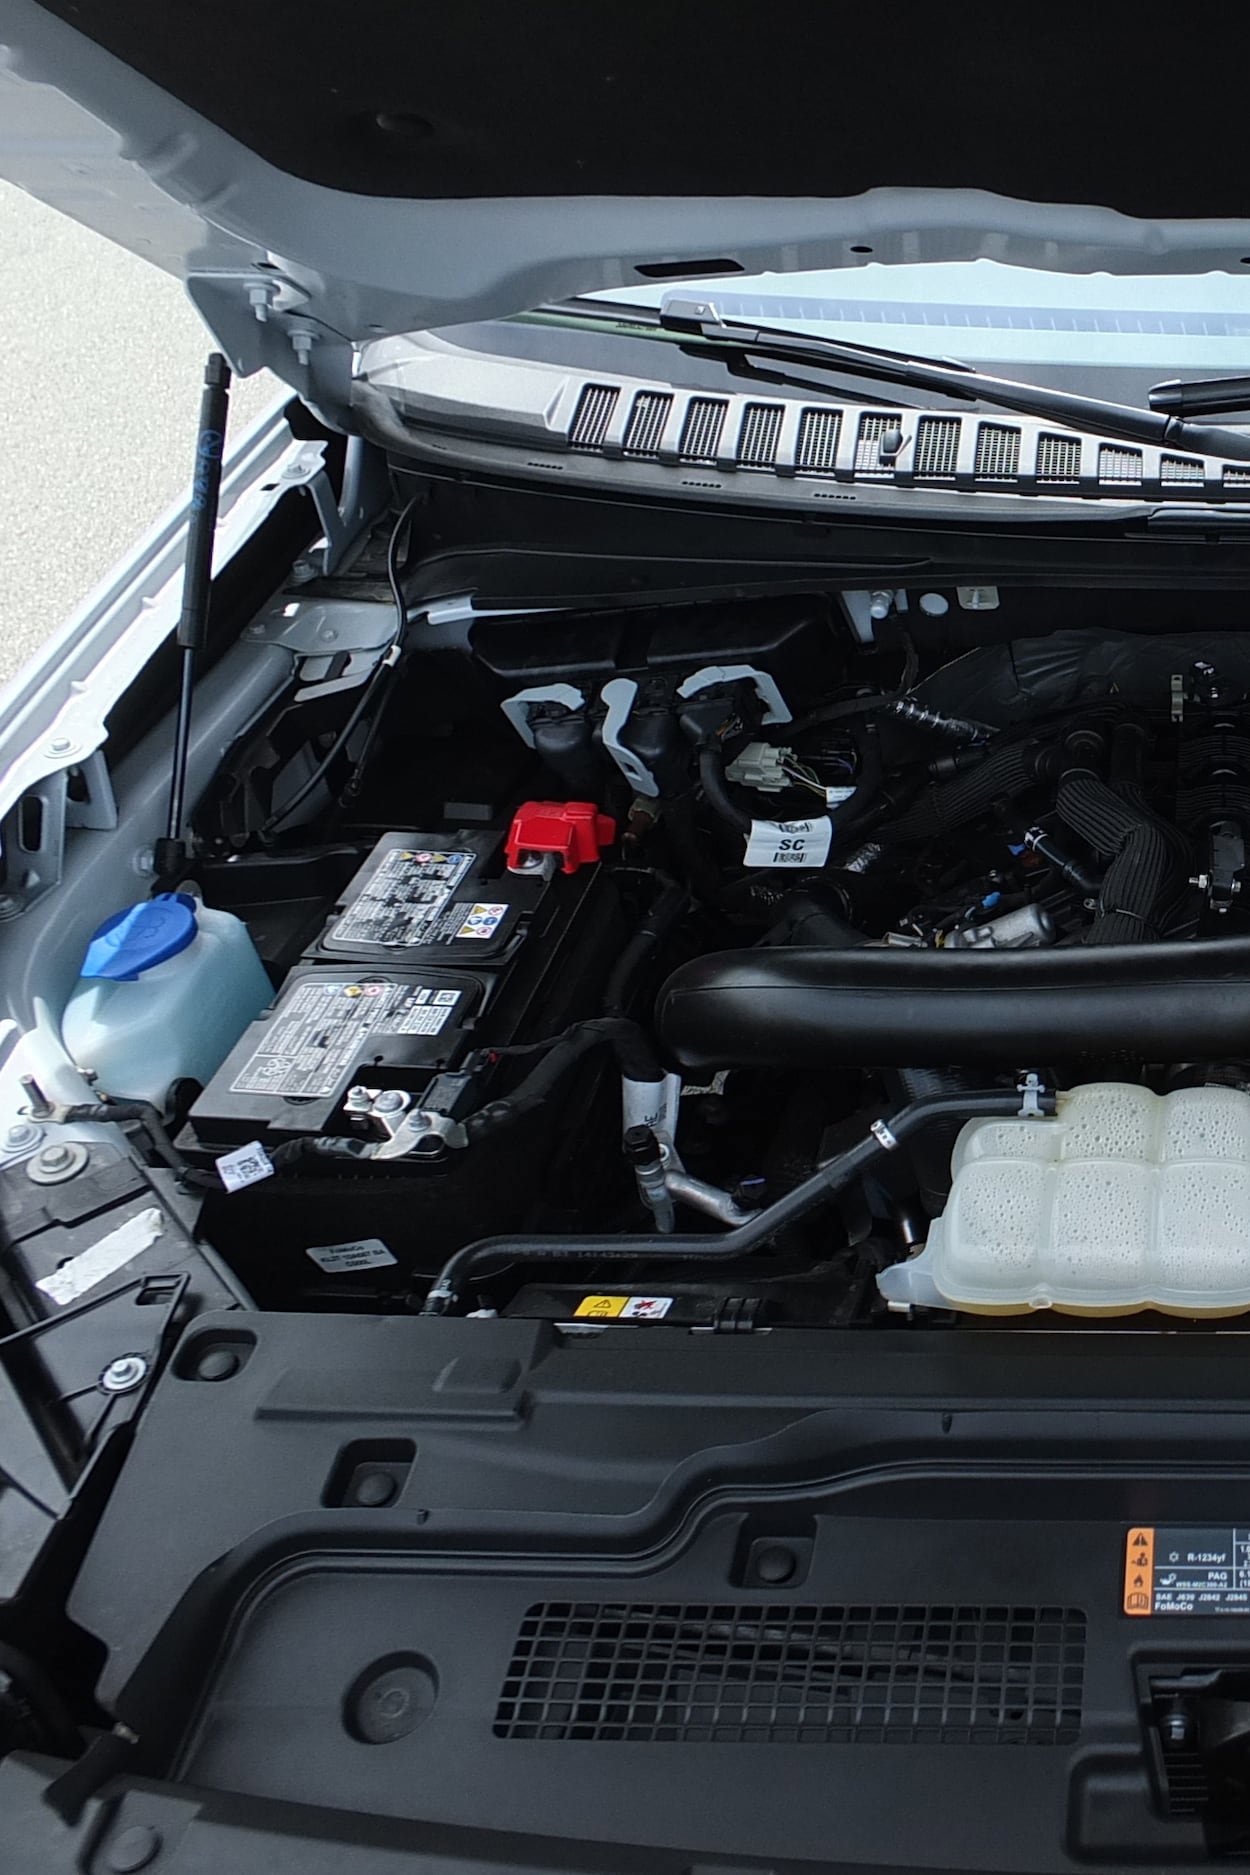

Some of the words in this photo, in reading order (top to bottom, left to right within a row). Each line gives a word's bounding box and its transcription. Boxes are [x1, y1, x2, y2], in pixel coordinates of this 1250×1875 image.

[778, 839, 805, 850] SC
[1187, 1553, 1226, 1564] R-1234yf
[1208, 1572, 1227, 1580] PAG
[1155, 1593, 1172, 1601] SAE
[1154, 1602, 1194, 1611] FoMoCo
